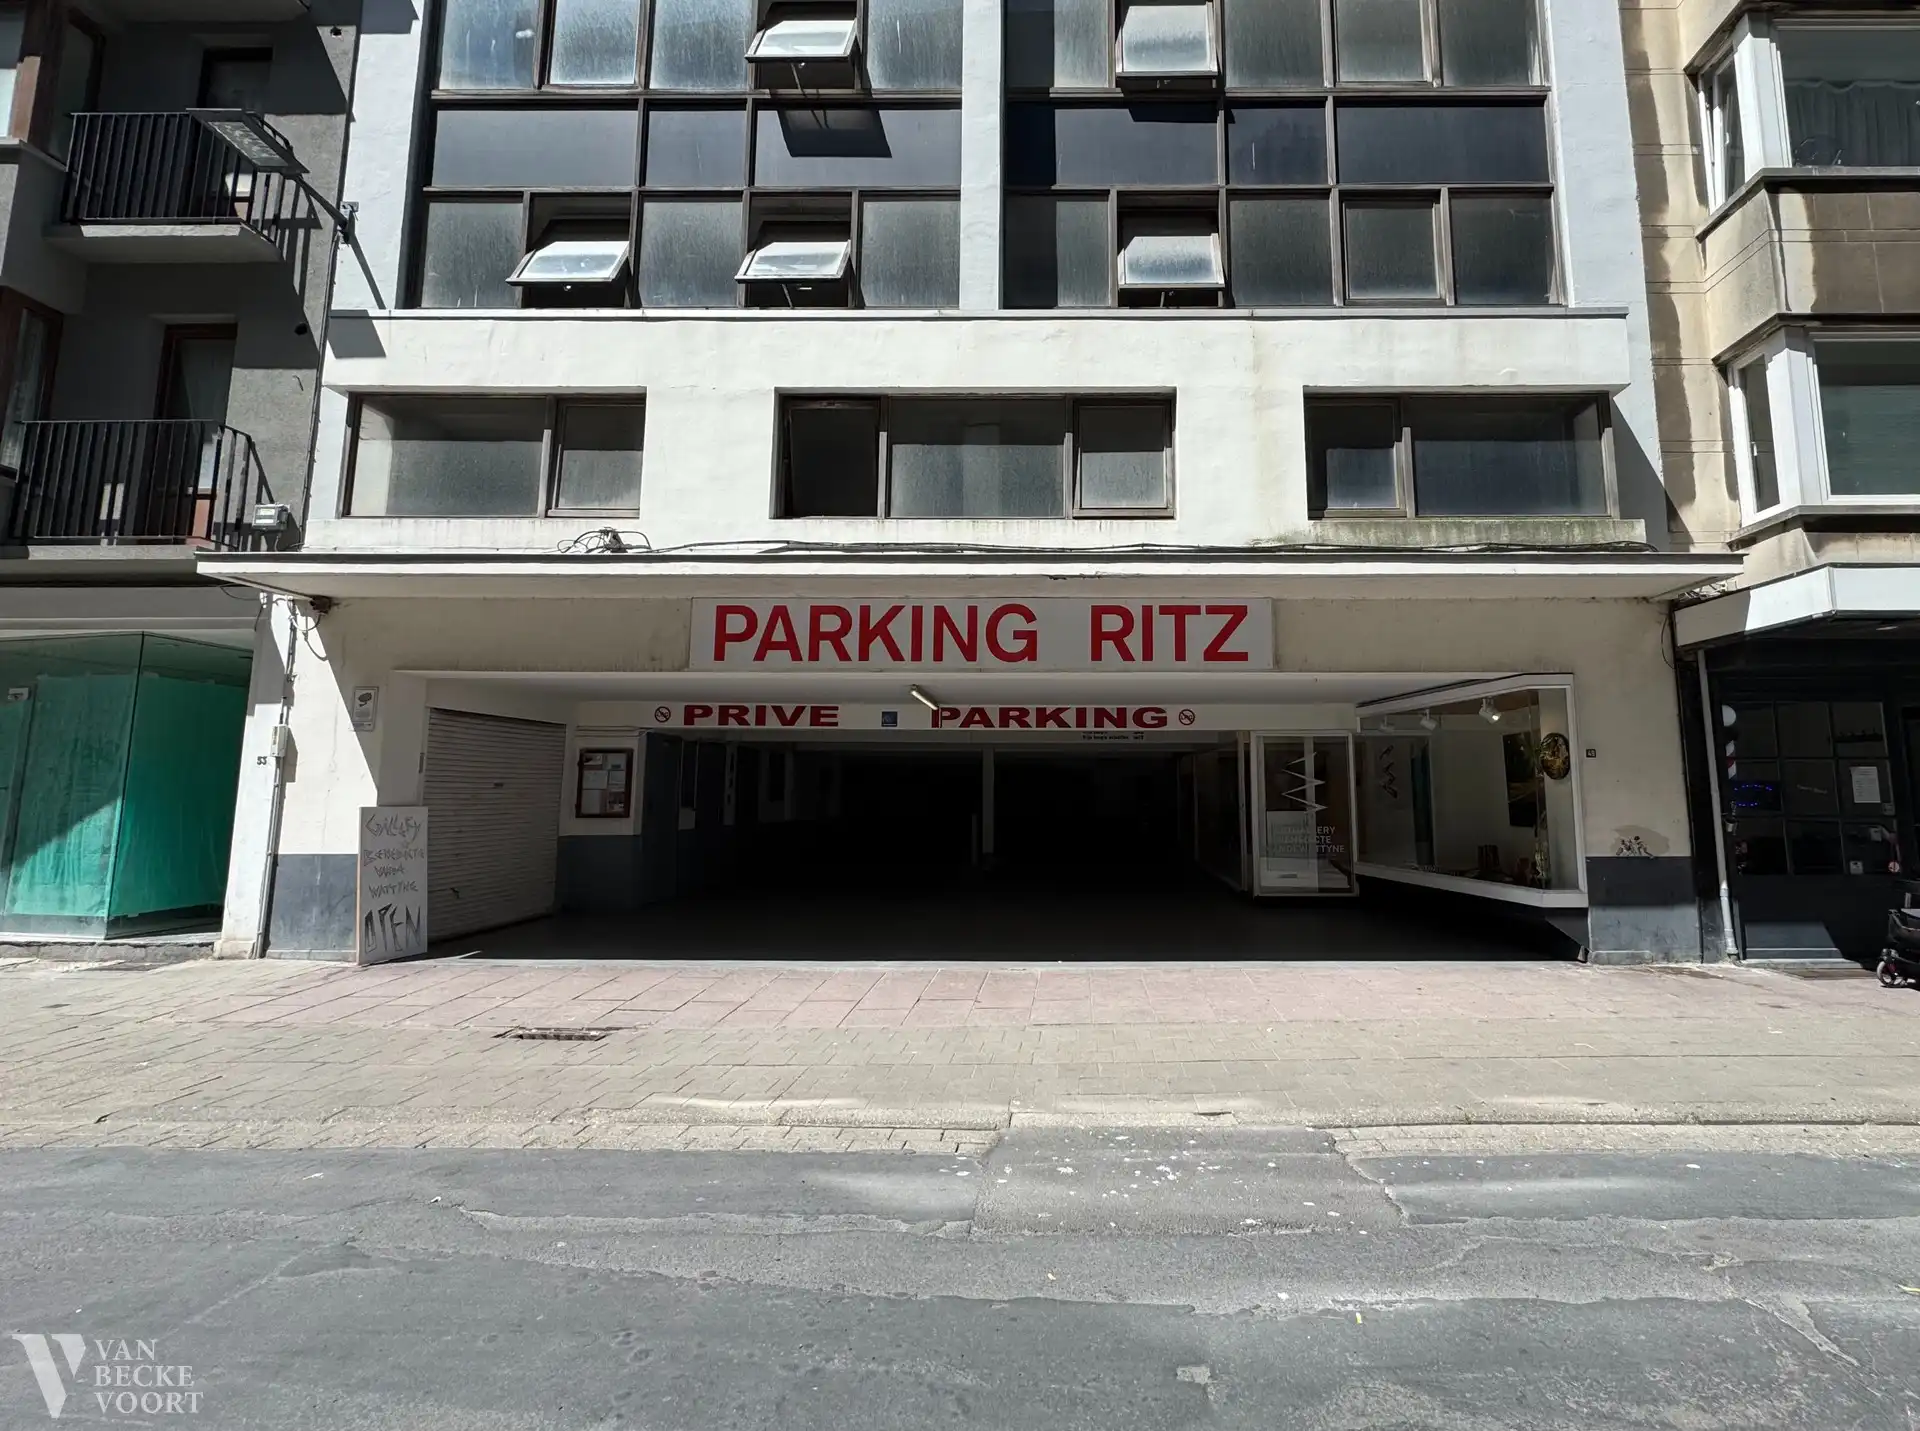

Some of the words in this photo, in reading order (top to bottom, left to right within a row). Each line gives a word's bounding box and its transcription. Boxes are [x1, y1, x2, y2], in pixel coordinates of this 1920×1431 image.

[714, 604, 1037, 662] PARKING
[1090, 604, 1248, 661] RITZ
[683, 705, 839, 727] PRIVE
[931, 706, 1167, 729] PARKING
[364, 903, 421, 954] OPEN
